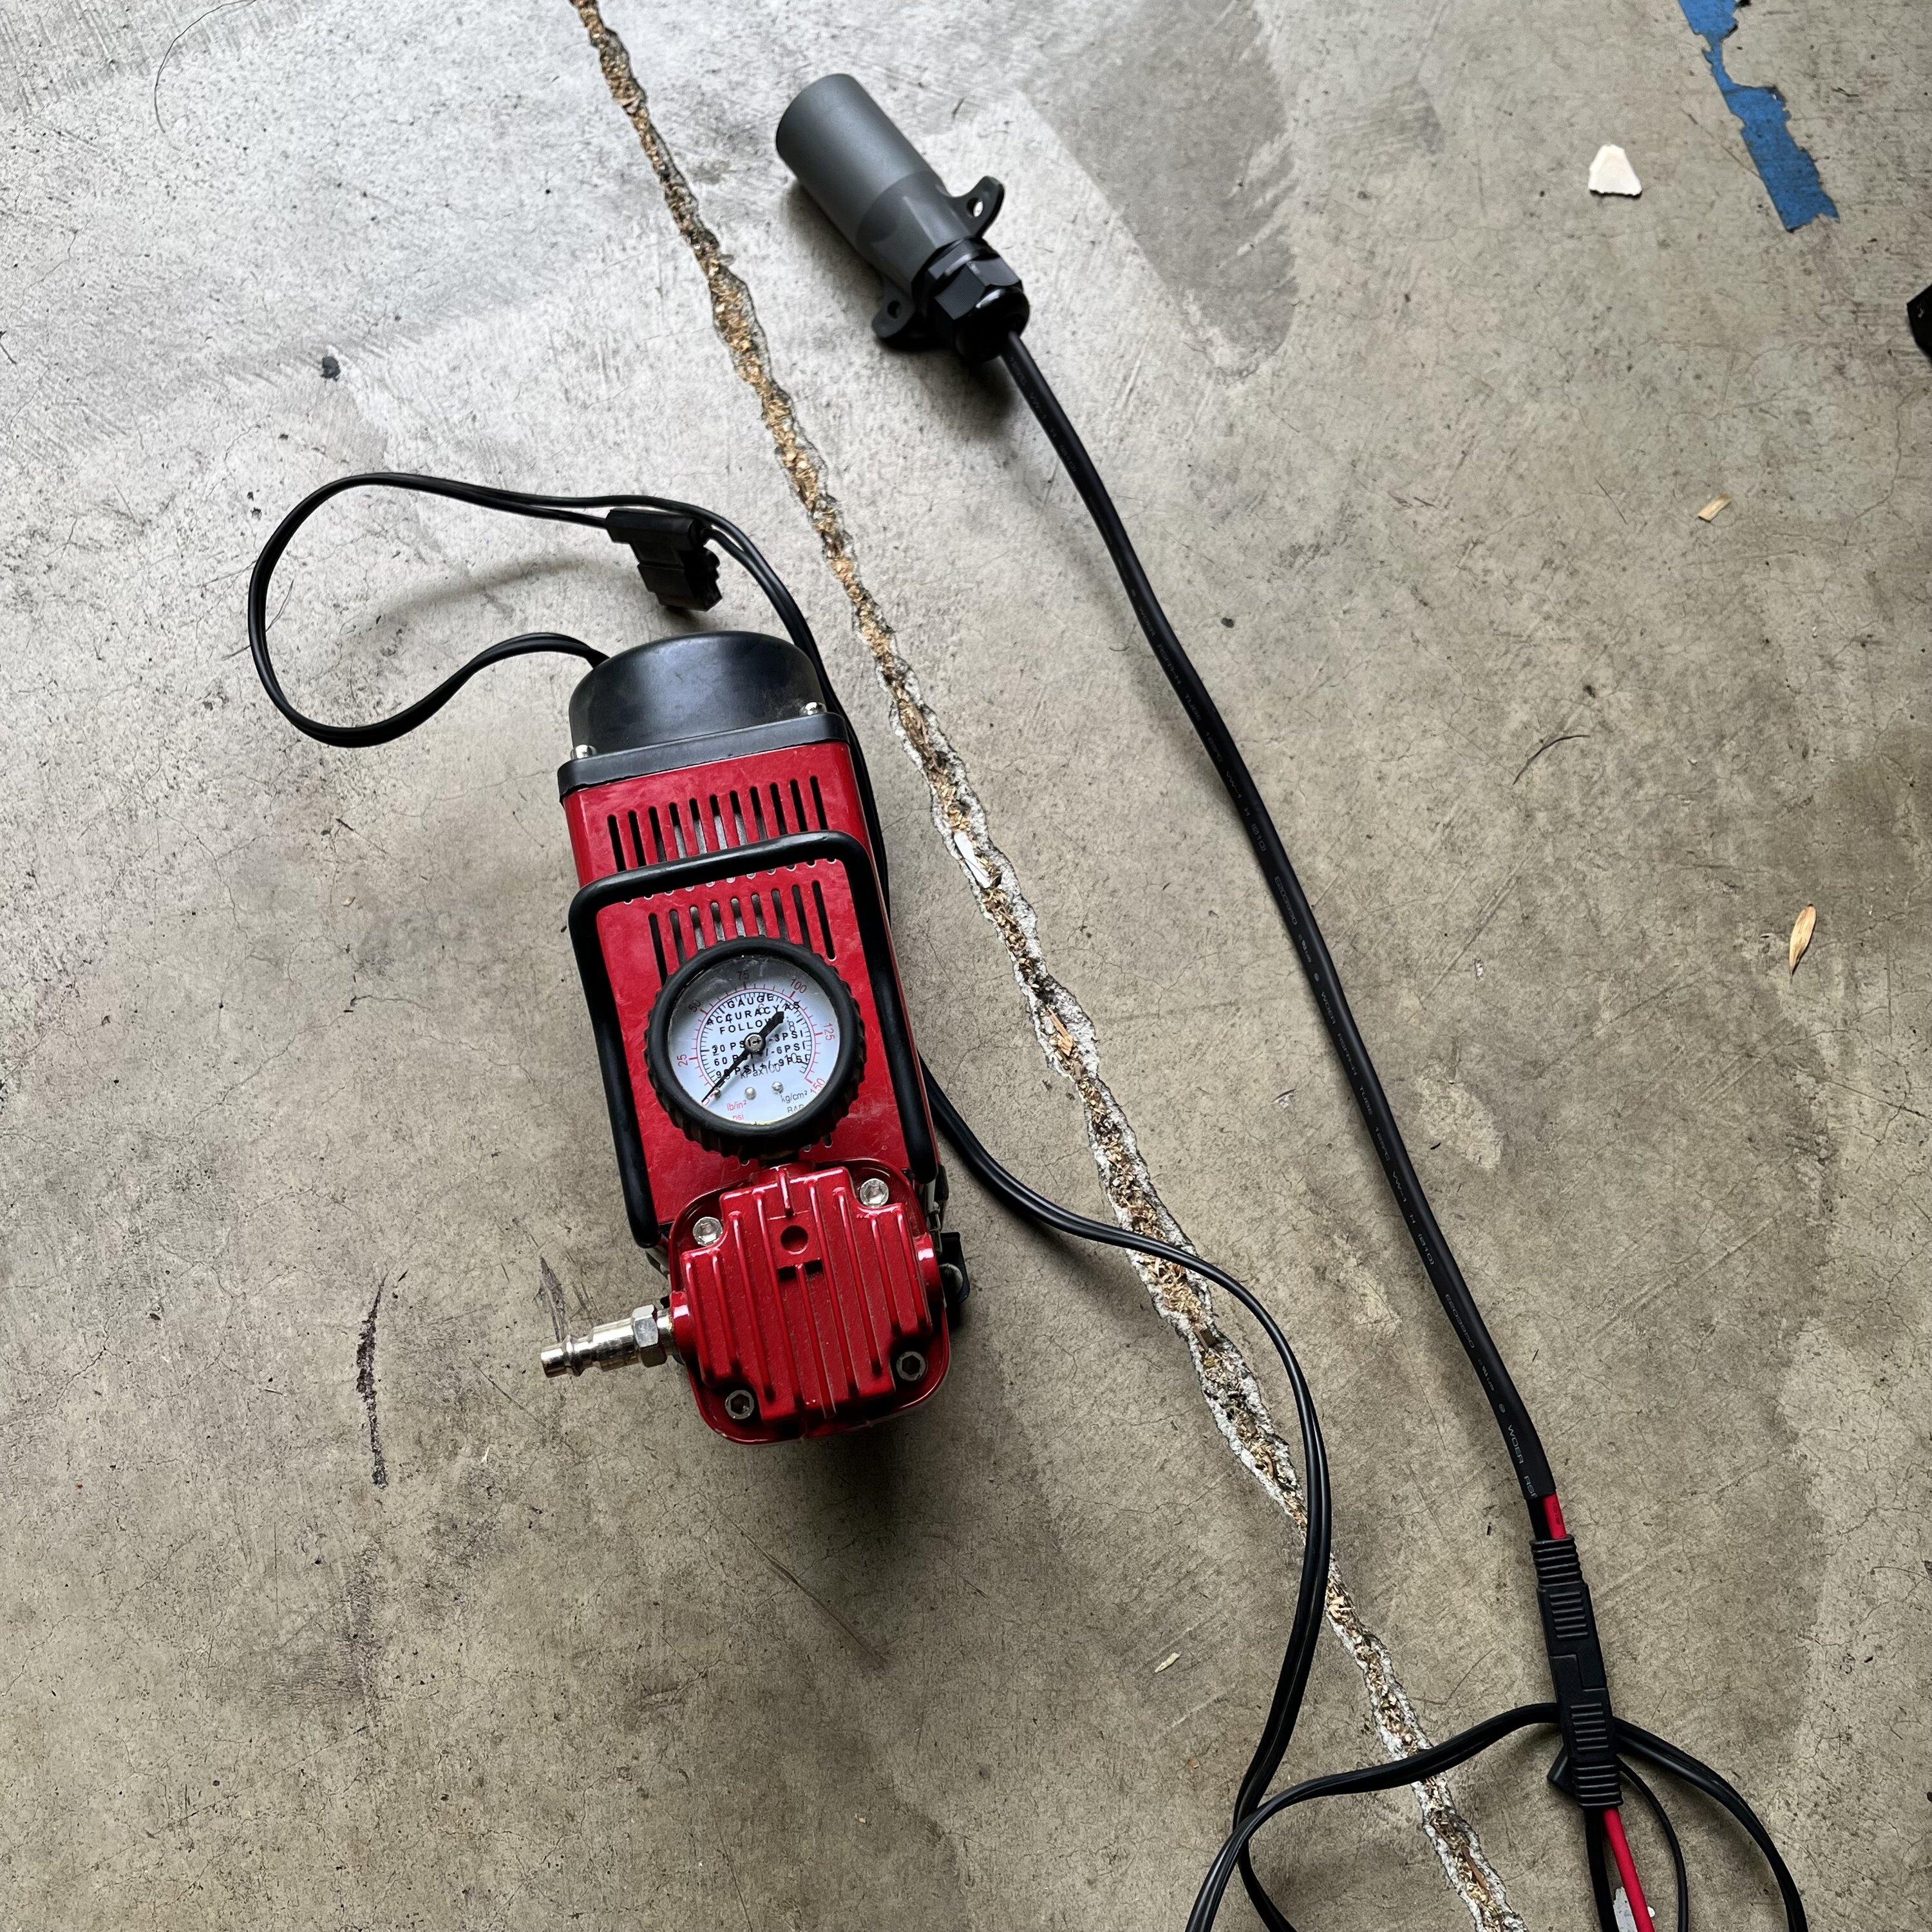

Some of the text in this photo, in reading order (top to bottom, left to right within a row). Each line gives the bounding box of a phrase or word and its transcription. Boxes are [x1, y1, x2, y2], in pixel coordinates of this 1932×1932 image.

[737, 969, 750, 980] 75
[790, 979, 808, 994] 100
[688, 999, 701, 1013] 50
[727, 993, 774, 1009] GAUGE
[707, 1001, 800, 1026] ACCURACY AS
[788, 1021, 795, 1033] 8
[824, 1023, 835, 1041] 125
[677, 1054, 687, 1066] 25
[714, 1057, 728, 1066] 60
[810, 1078, 825, 1095] 150
[1508, 1425, 1524, 1464] WOER
